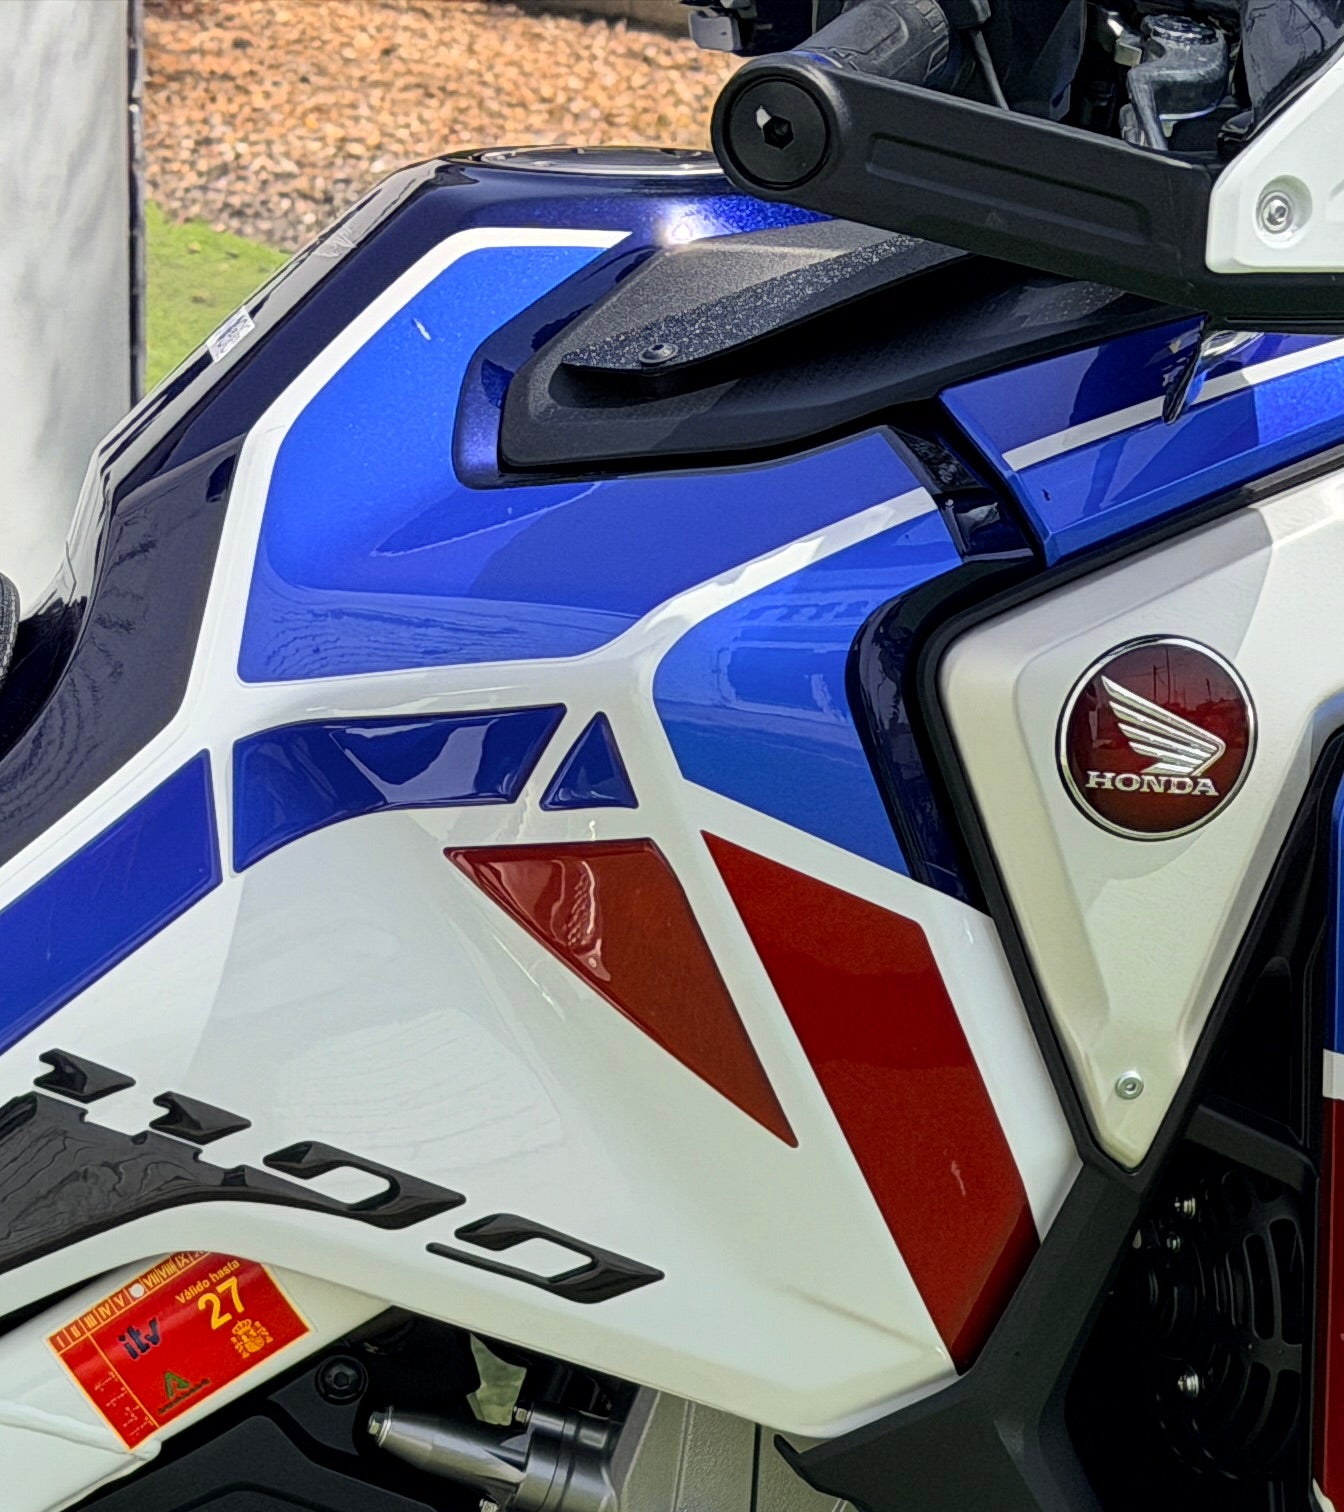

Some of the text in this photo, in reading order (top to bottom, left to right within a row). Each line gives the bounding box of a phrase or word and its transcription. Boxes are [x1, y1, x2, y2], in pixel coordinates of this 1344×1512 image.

[1085, 771, 1219, 796] HONDA
[175, 1259, 240, 1304] Válido hasta
[98, 1305, 112, 1319] IV
[114, 1295, 126, 1308] V
[197, 1275, 245, 1331] 27
